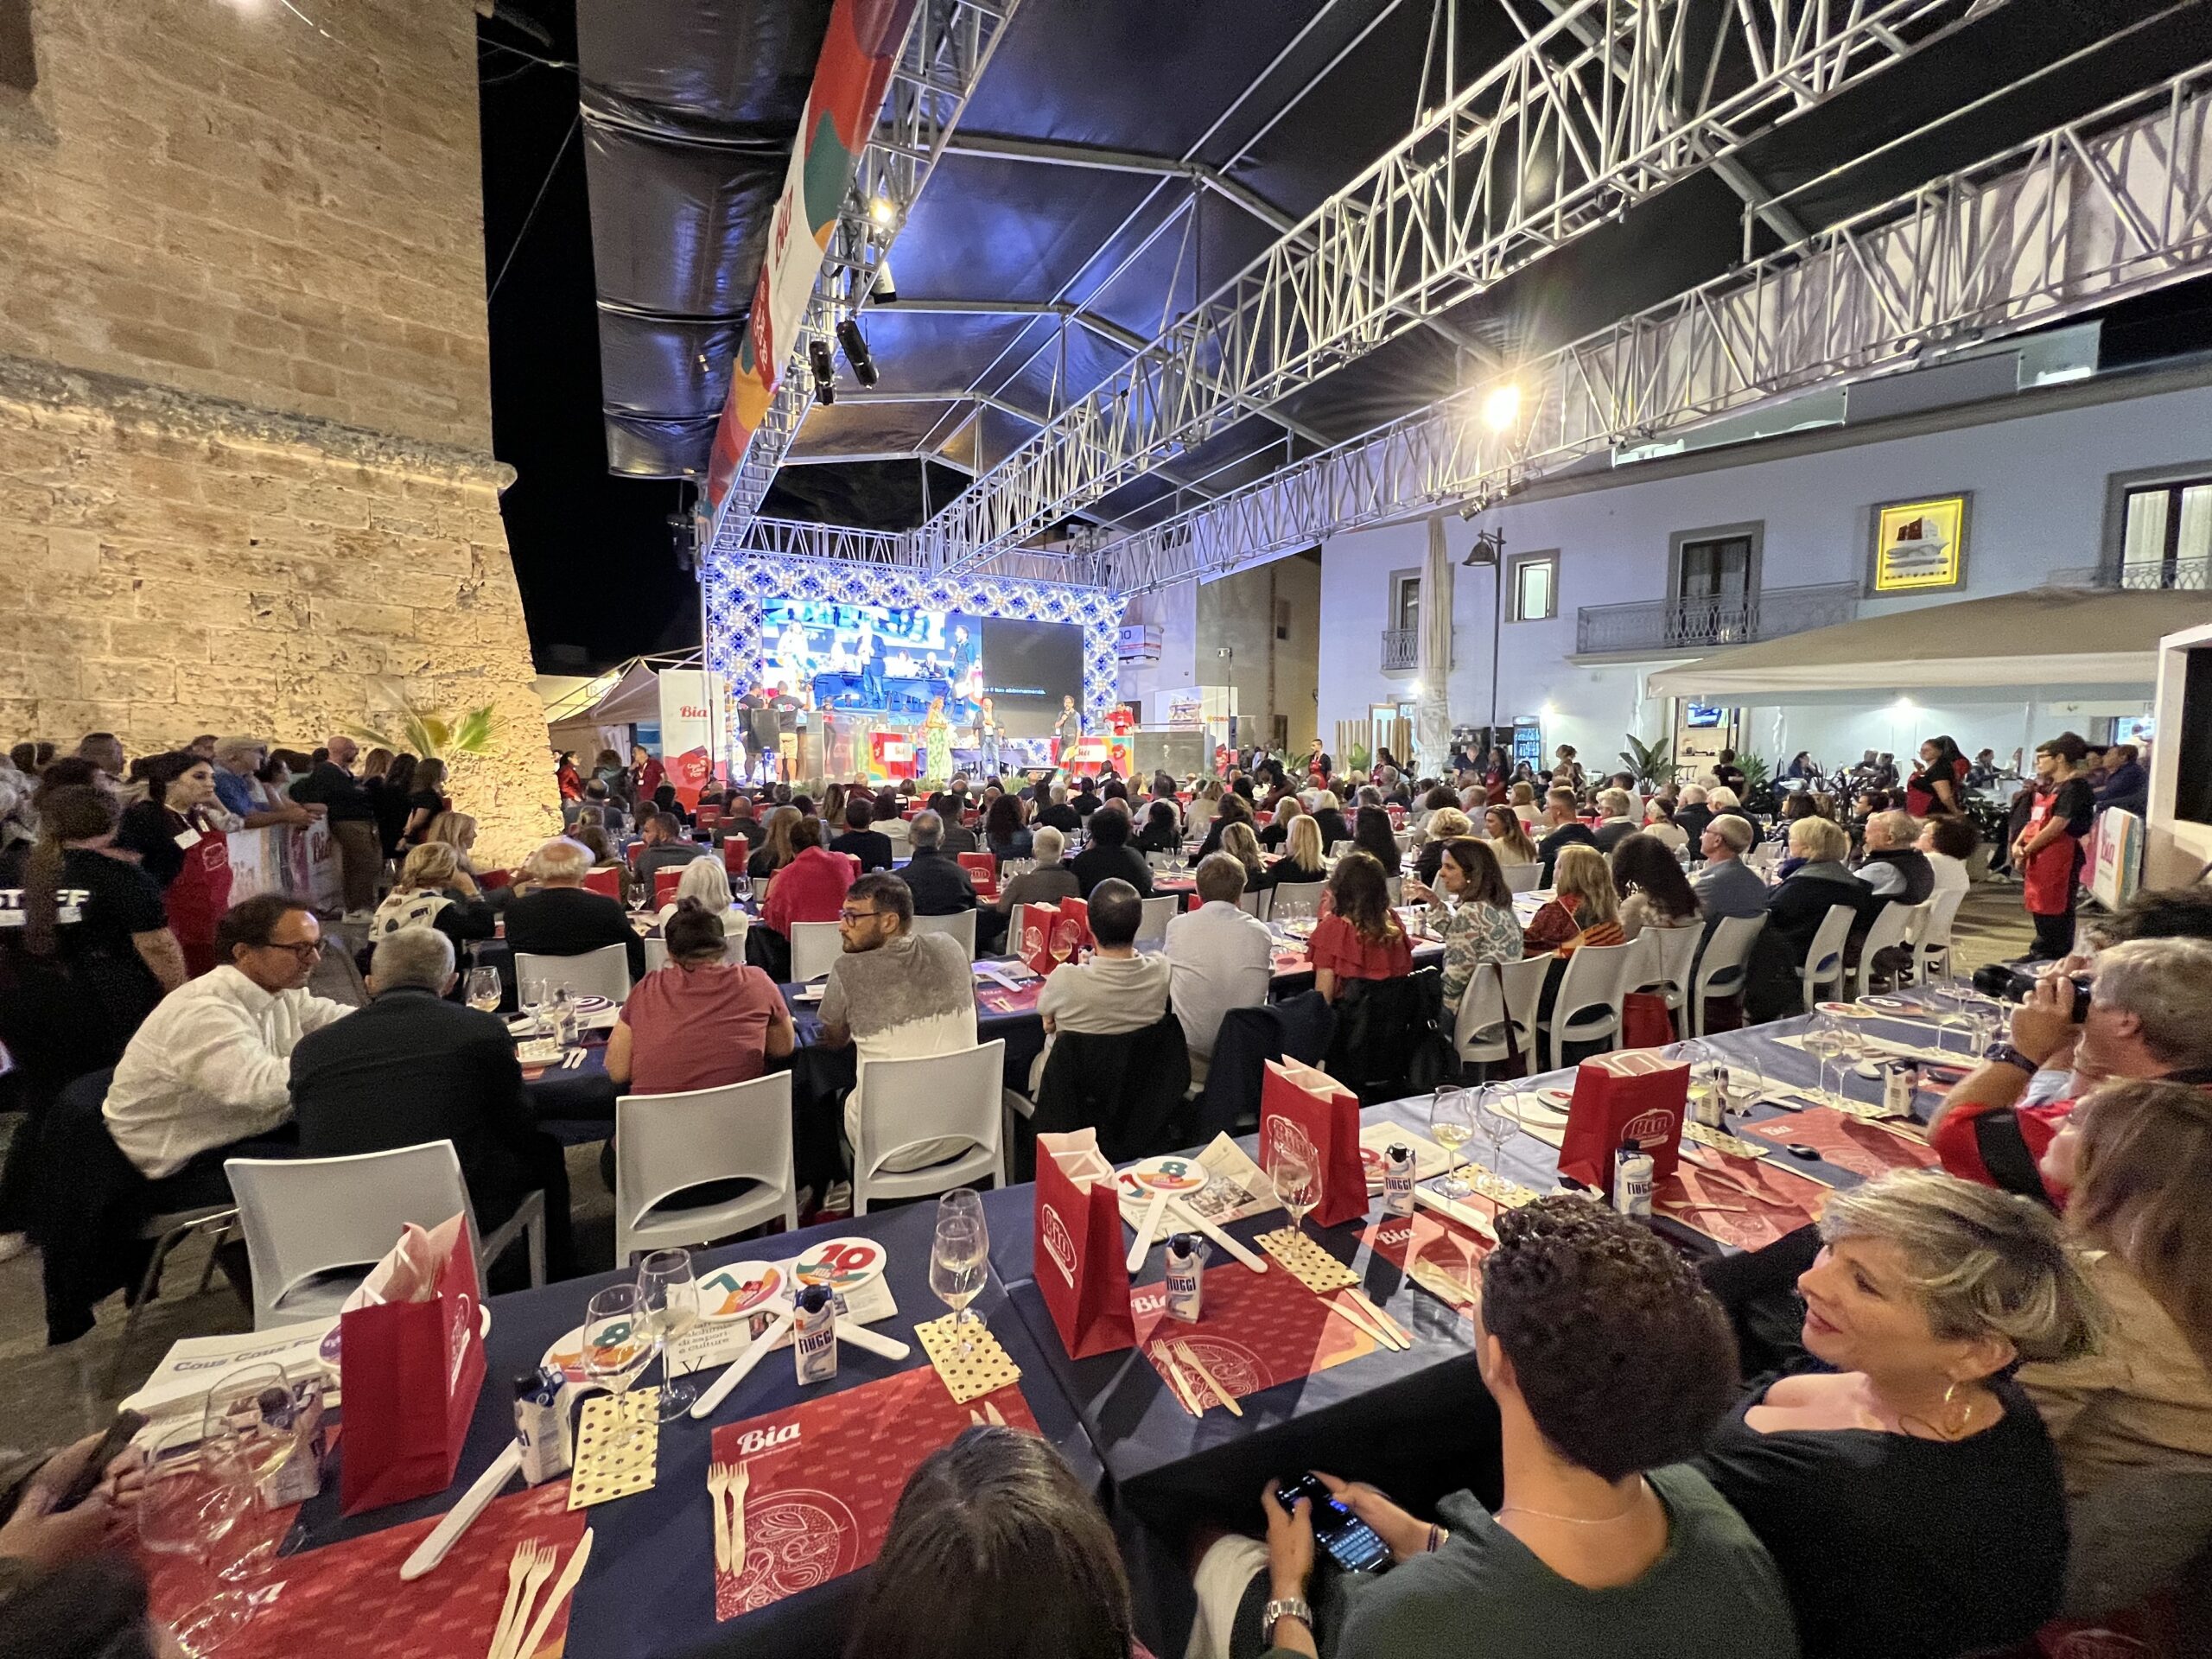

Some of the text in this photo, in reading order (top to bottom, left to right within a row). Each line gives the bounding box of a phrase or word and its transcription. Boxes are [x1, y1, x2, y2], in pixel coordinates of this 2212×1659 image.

[680, 705, 708, 718] Bia
[1159, 1161, 1188, 1177] 8
[822, 1243, 876, 1270] 10
[593, 1322, 631, 1348] 8
[798, 1325, 835, 1355] FIUGGI
[174, 1358, 228, 1372] Cous
[234, 1345, 287, 1362] Cous
[736, 1422, 802, 1456] Bia
